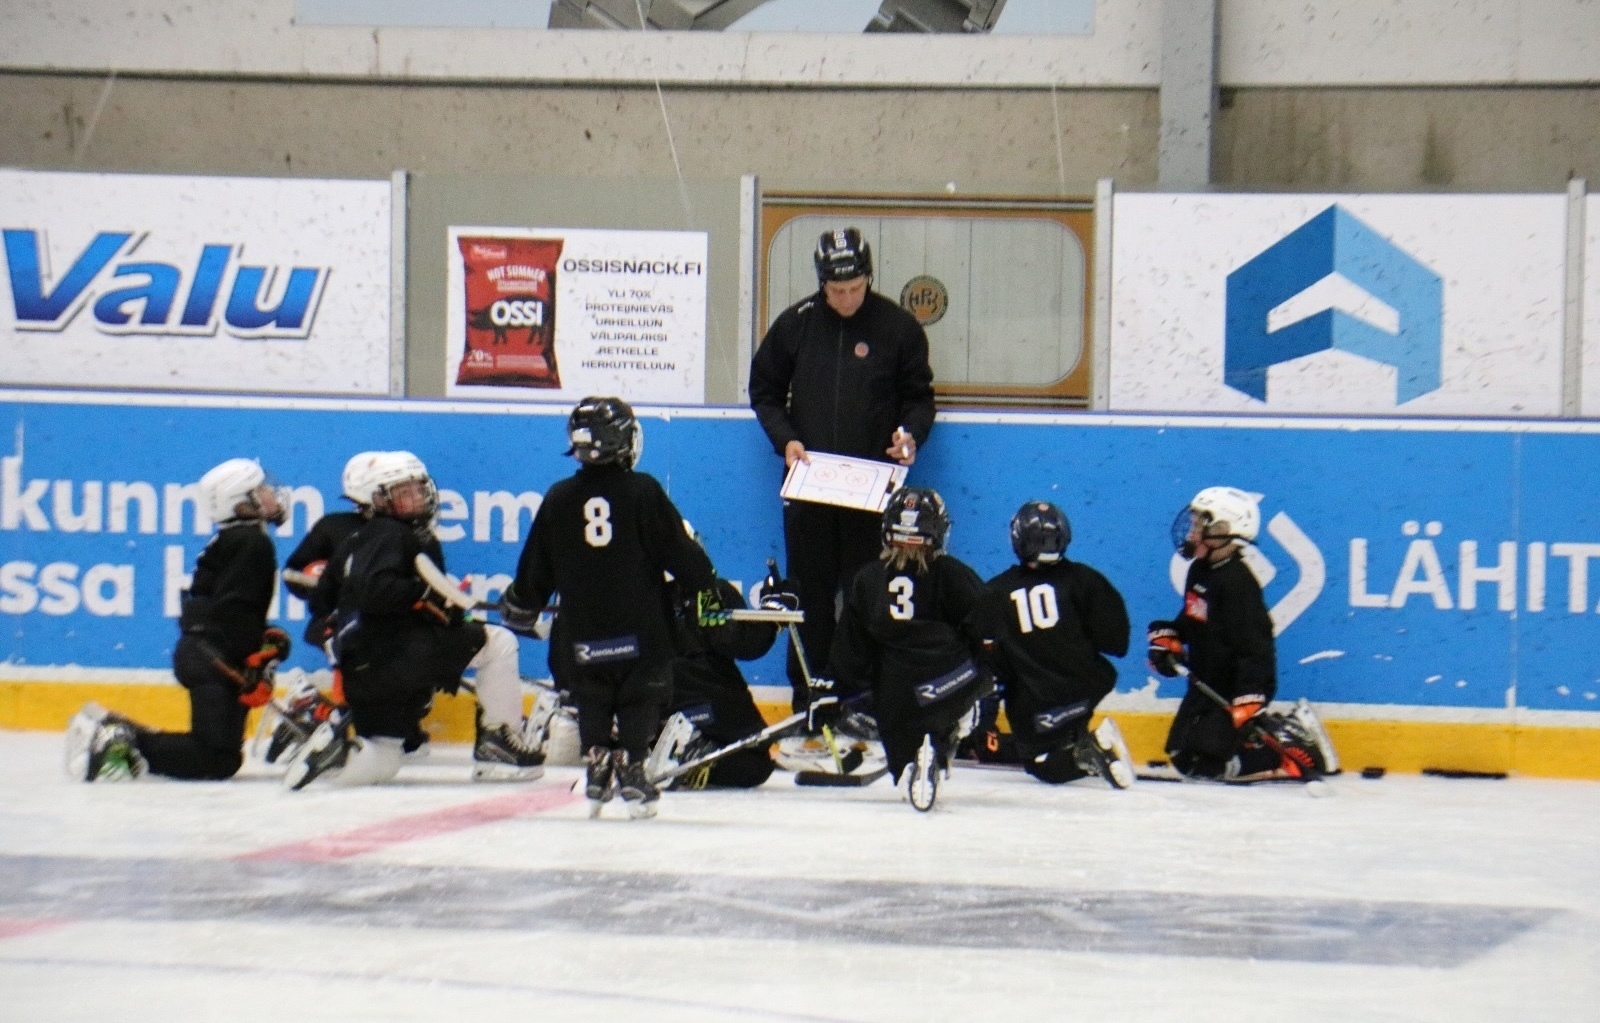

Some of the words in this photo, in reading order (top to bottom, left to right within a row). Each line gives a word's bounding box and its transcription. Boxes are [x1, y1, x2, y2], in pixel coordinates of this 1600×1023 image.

[562, 257, 702, 275] OSSISNACK.FI
[2, 229, 325, 334] Valu
[607, 289, 626, 299] YLI
[490, 300, 543, 326] OSSI
[595, 317, 663, 328] URHEILUUN
[598, 345, 659, 356] RETKELLE
[580, 359, 676, 371] HERKUTTELUUN
[583, 496, 613, 548] 8
[1348, 520, 1600, 614] LÄHIT
[888, 576, 915, 620] 3
[1010, 583, 1060, 633] 10
